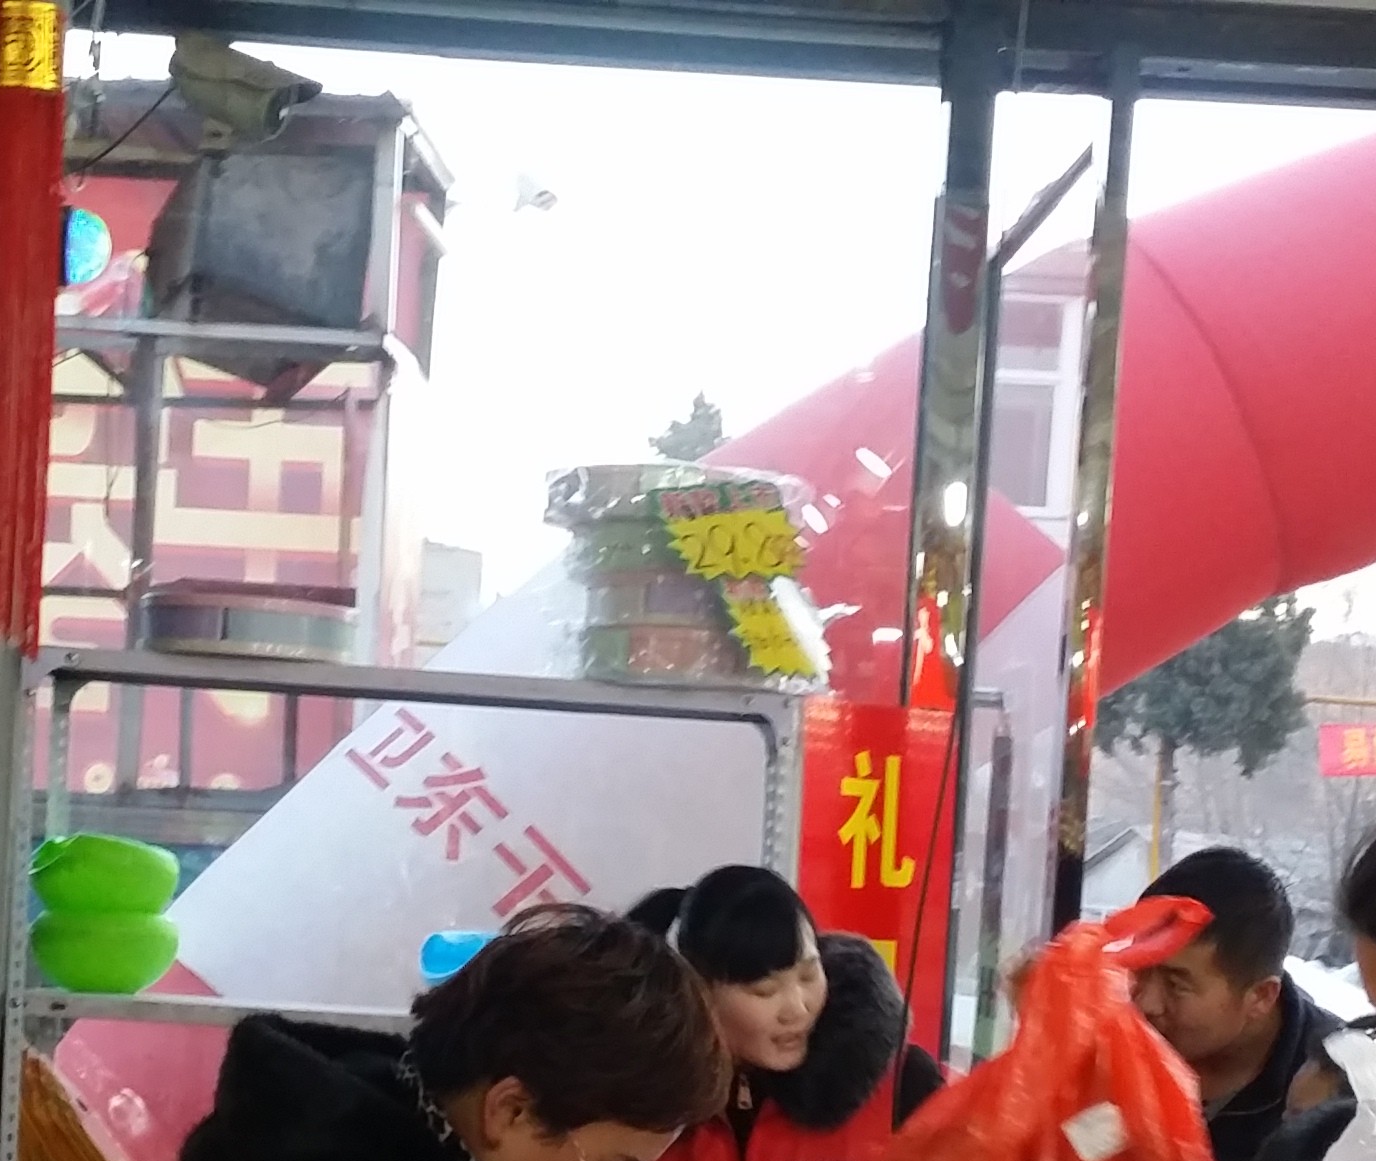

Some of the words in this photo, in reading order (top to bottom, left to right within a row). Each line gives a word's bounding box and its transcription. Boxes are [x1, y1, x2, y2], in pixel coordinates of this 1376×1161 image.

[344, 706, 593, 919] 卫东干
[838, 750, 916, 889] 礼
